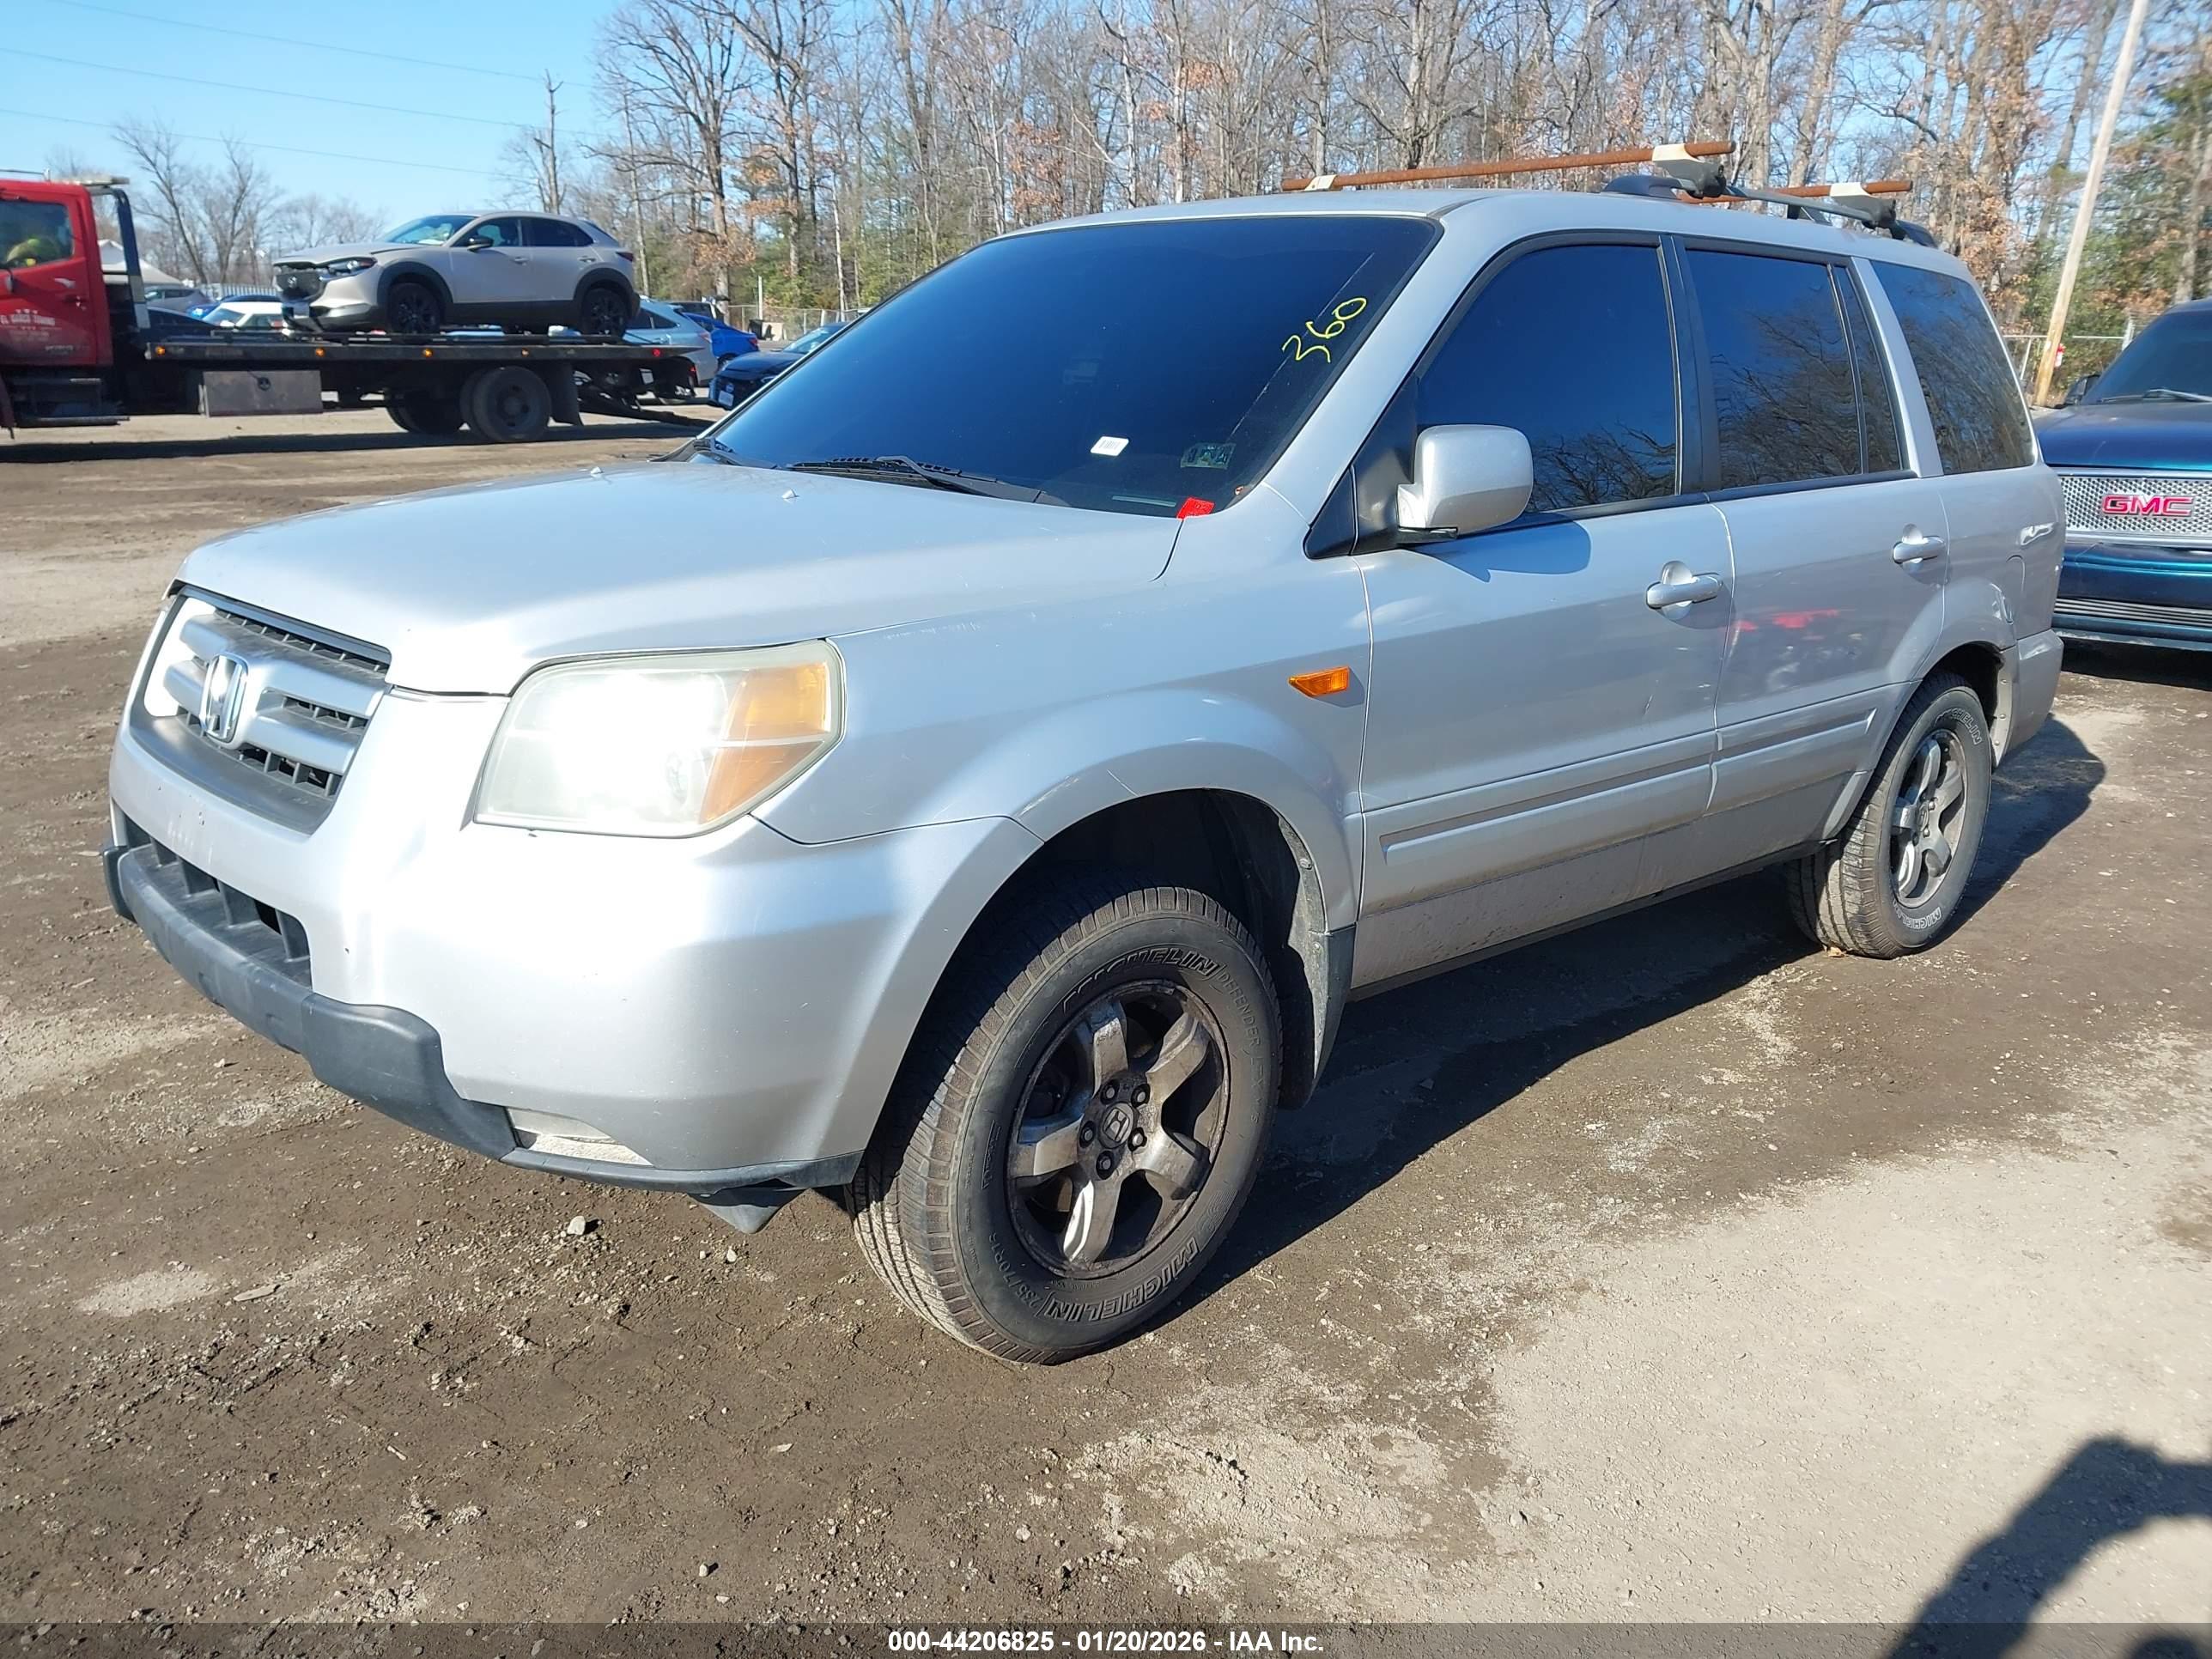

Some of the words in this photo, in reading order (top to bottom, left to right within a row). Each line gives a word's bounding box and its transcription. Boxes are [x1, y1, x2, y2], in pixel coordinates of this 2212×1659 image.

[1281, 297, 1367, 363] 360
[2101, 494, 2194, 517] GMC
[1934, 707, 1983, 745] CHELIN
[1216, 971, 1261, 1047] DEFENDER
[1044, 1237, 1200, 1322] MICHELIN
